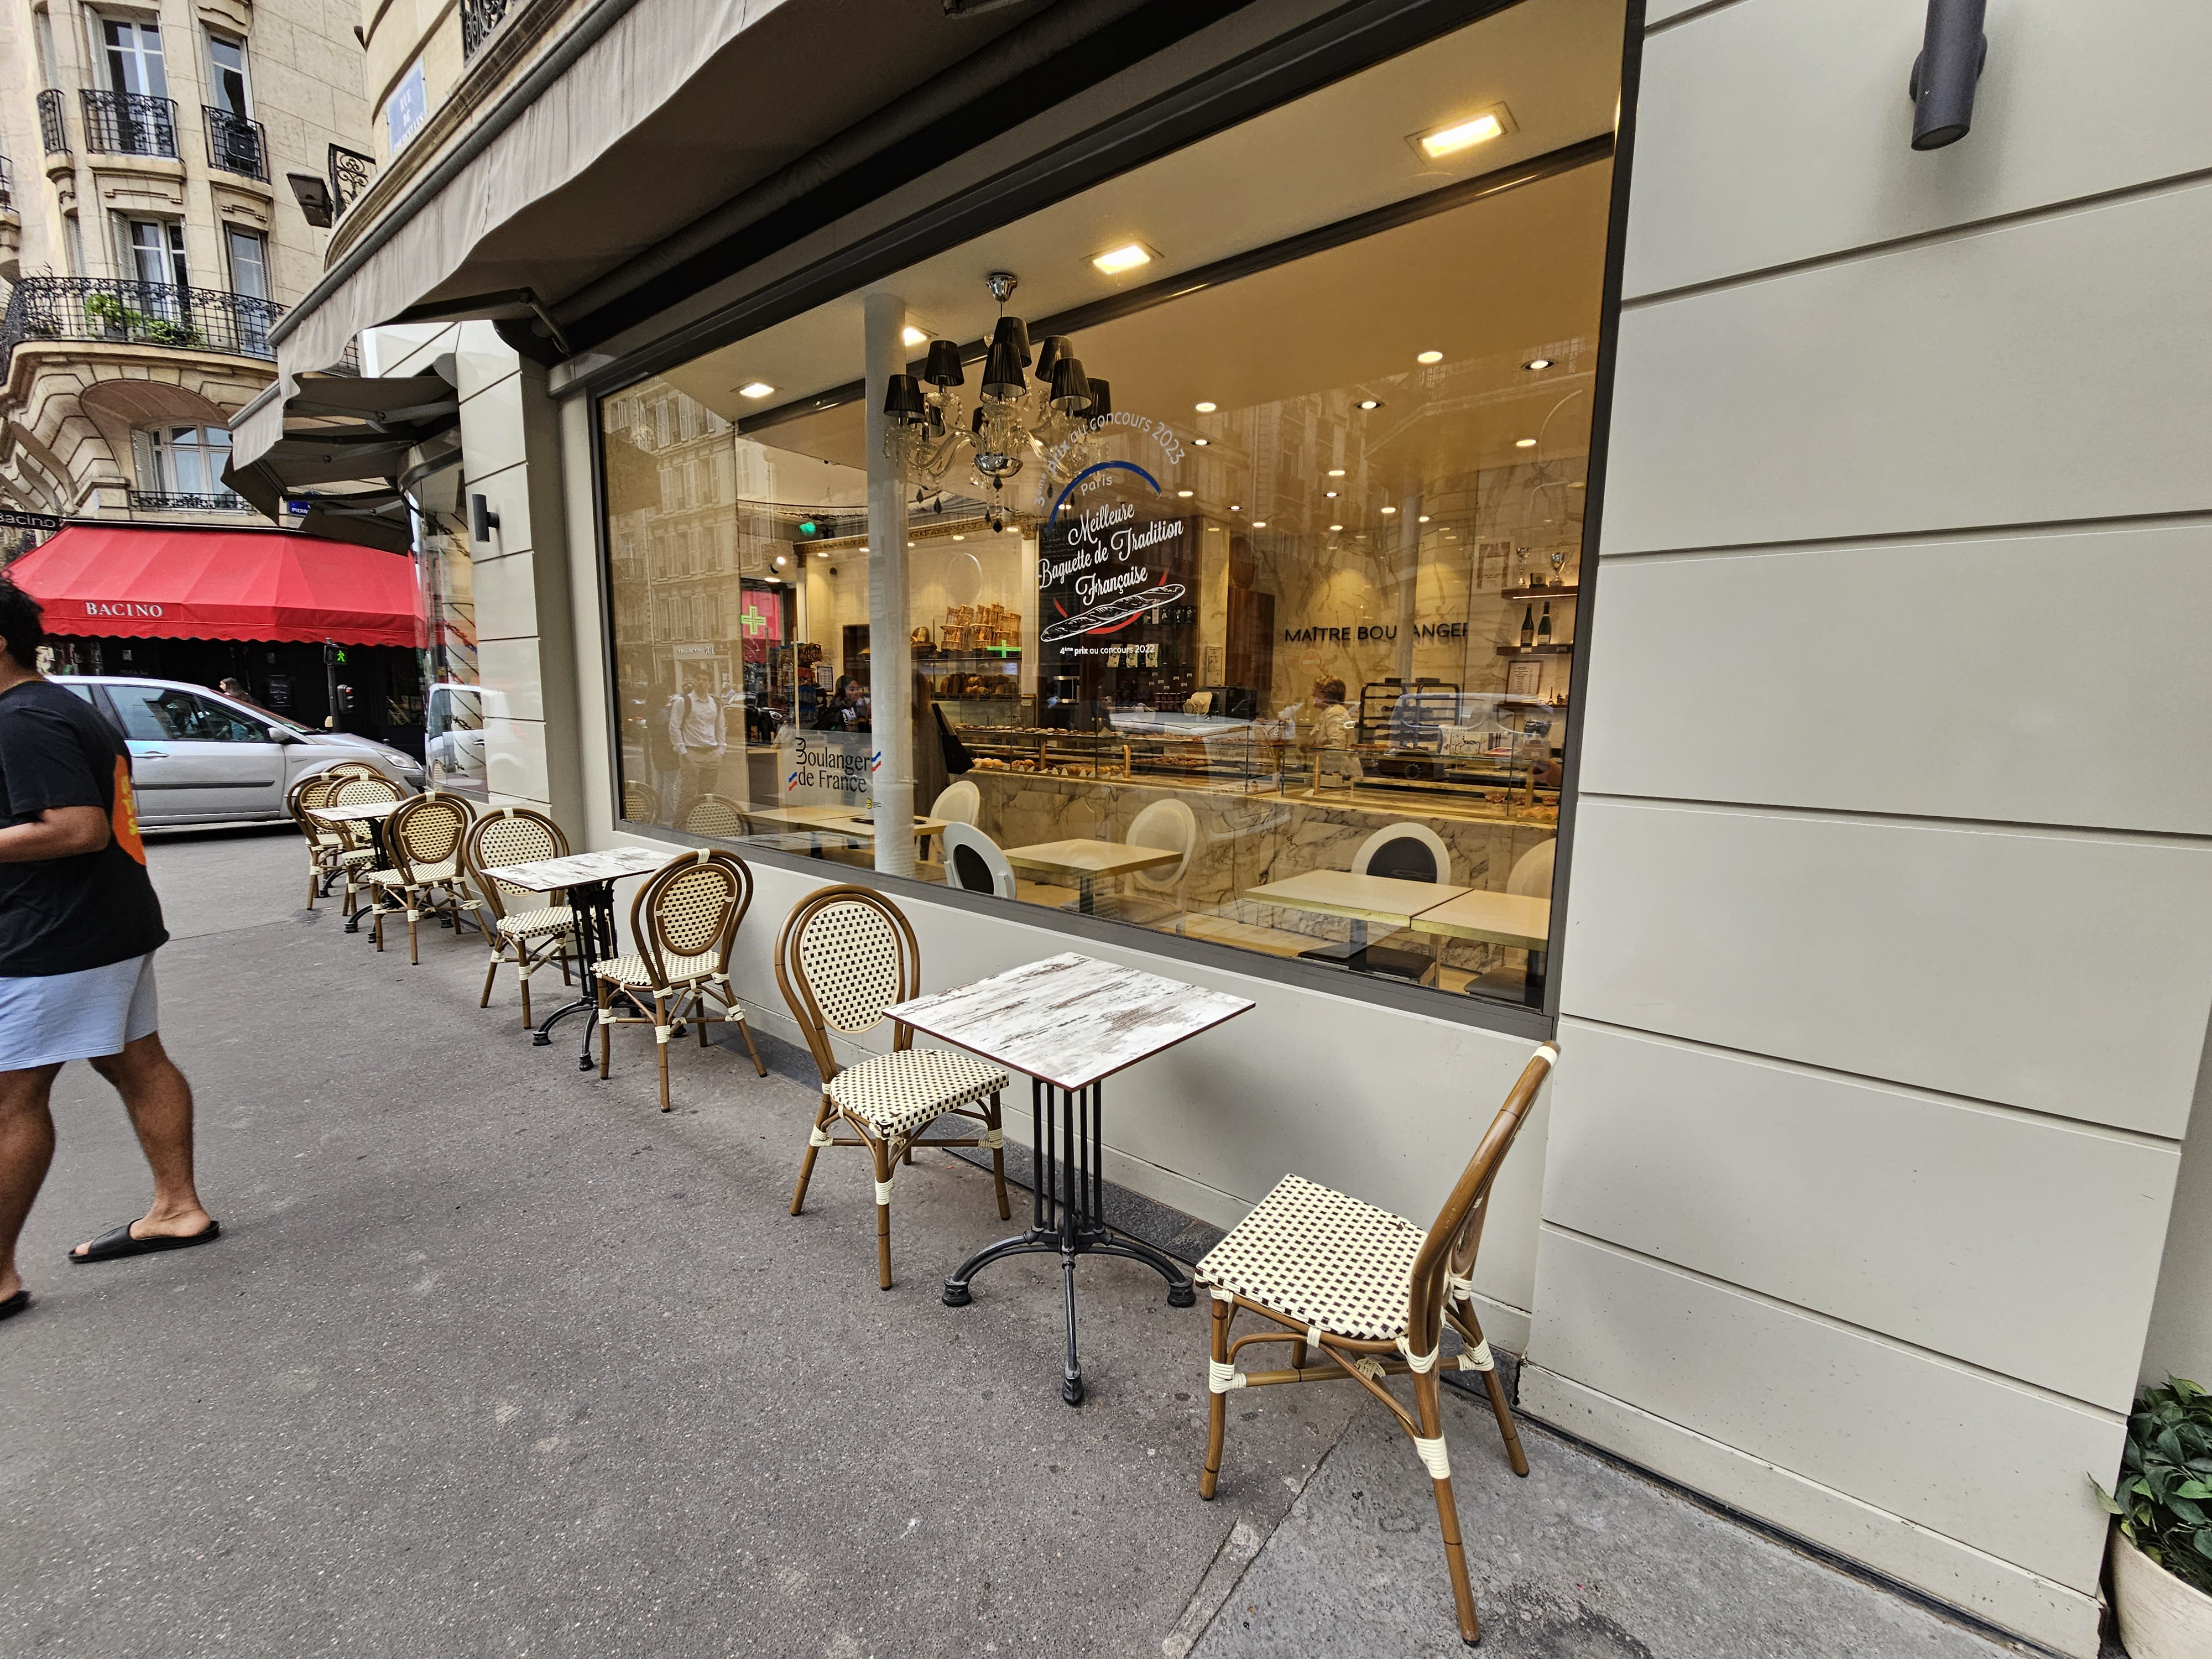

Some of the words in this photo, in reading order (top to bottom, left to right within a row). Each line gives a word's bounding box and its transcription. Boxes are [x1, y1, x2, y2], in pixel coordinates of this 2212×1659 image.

[1071, 424, 1087, 444] au
[1090, 411, 1152, 432] concours
[1151, 421, 1185, 466] 2023
[1081, 474, 1113, 496] Paris
[1068, 503, 1135, 546] Meilleure
[1036, 549, 1092, 589] Baguette
[1094, 540, 1109, 565] de
[1110, 520, 1185, 561] Tradition
[1075, 566, 1148, 606] Française
[85, 601, 163, 617] BACINO
[1285, 626, 1351, 641] MAÎTRE
[1357, 622, 1468, 640] BOUANGE
[1074, 645, 1088, 656] prix
[1135, 644, 1155, 653] 2022
[795, 737, 870, 775] Boulanger
[798, 766, 815, 786] de
[820, 770, 867, 793] France
